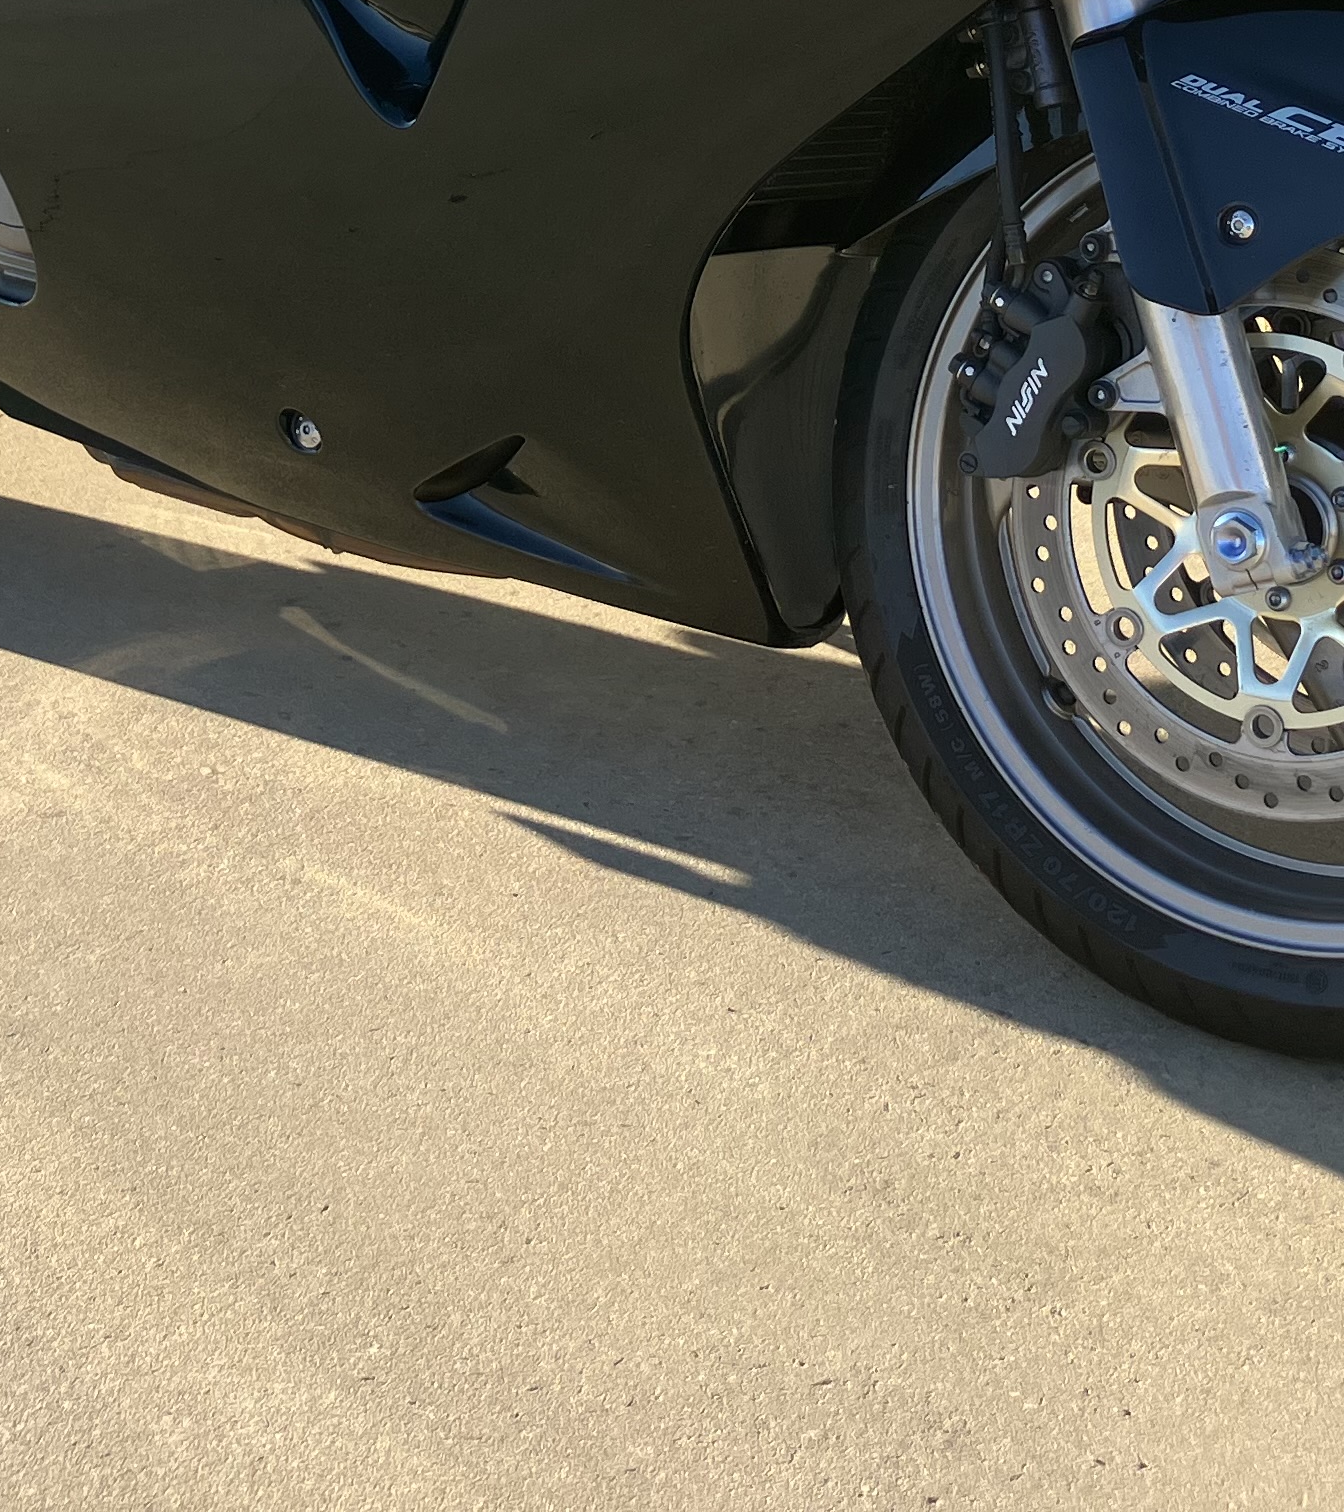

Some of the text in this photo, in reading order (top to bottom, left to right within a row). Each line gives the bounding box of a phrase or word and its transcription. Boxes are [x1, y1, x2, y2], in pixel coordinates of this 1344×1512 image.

[1170, 80, 1261, 119] COMBINED
[1259, 115, 1323, 143] BRAKE
[1180, 74, 1263, 114] DUAL
[1042, 855, 1137, 932] 120/70
